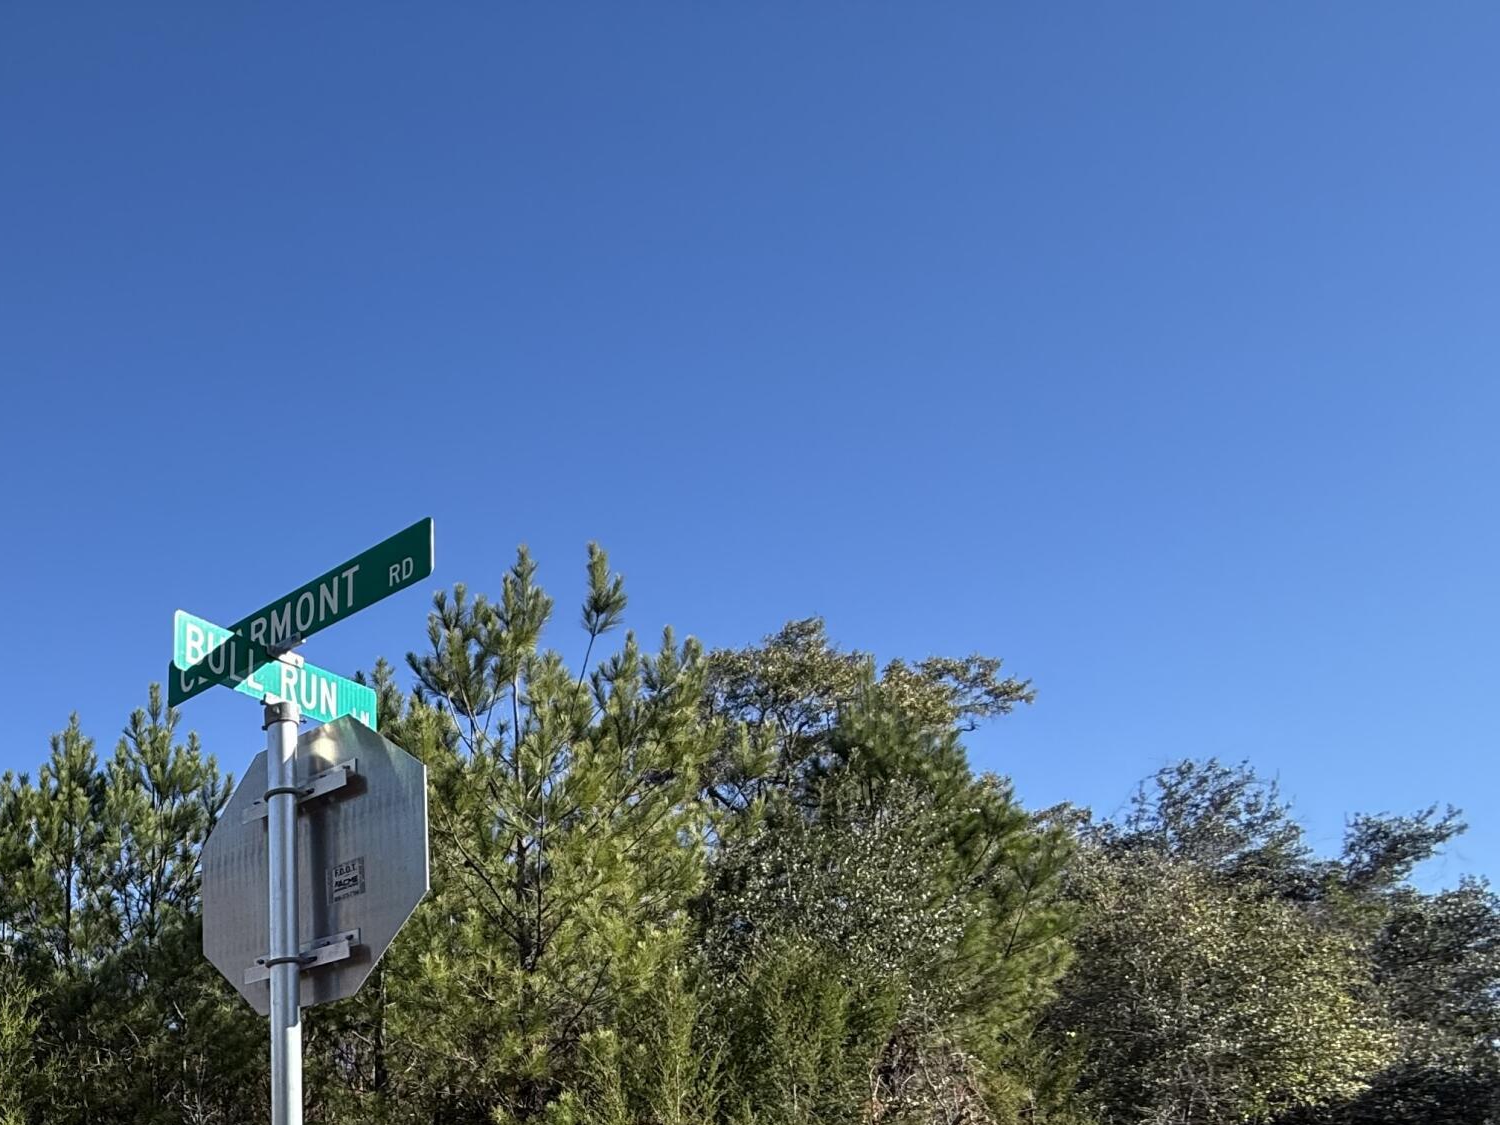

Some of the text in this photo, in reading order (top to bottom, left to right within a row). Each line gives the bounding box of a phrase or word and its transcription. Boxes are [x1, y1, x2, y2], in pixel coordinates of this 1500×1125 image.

[389, 557, 414, 587] RD
[186, 622, 265, 690] BULL
[281, 664, 338, 718] RUN
